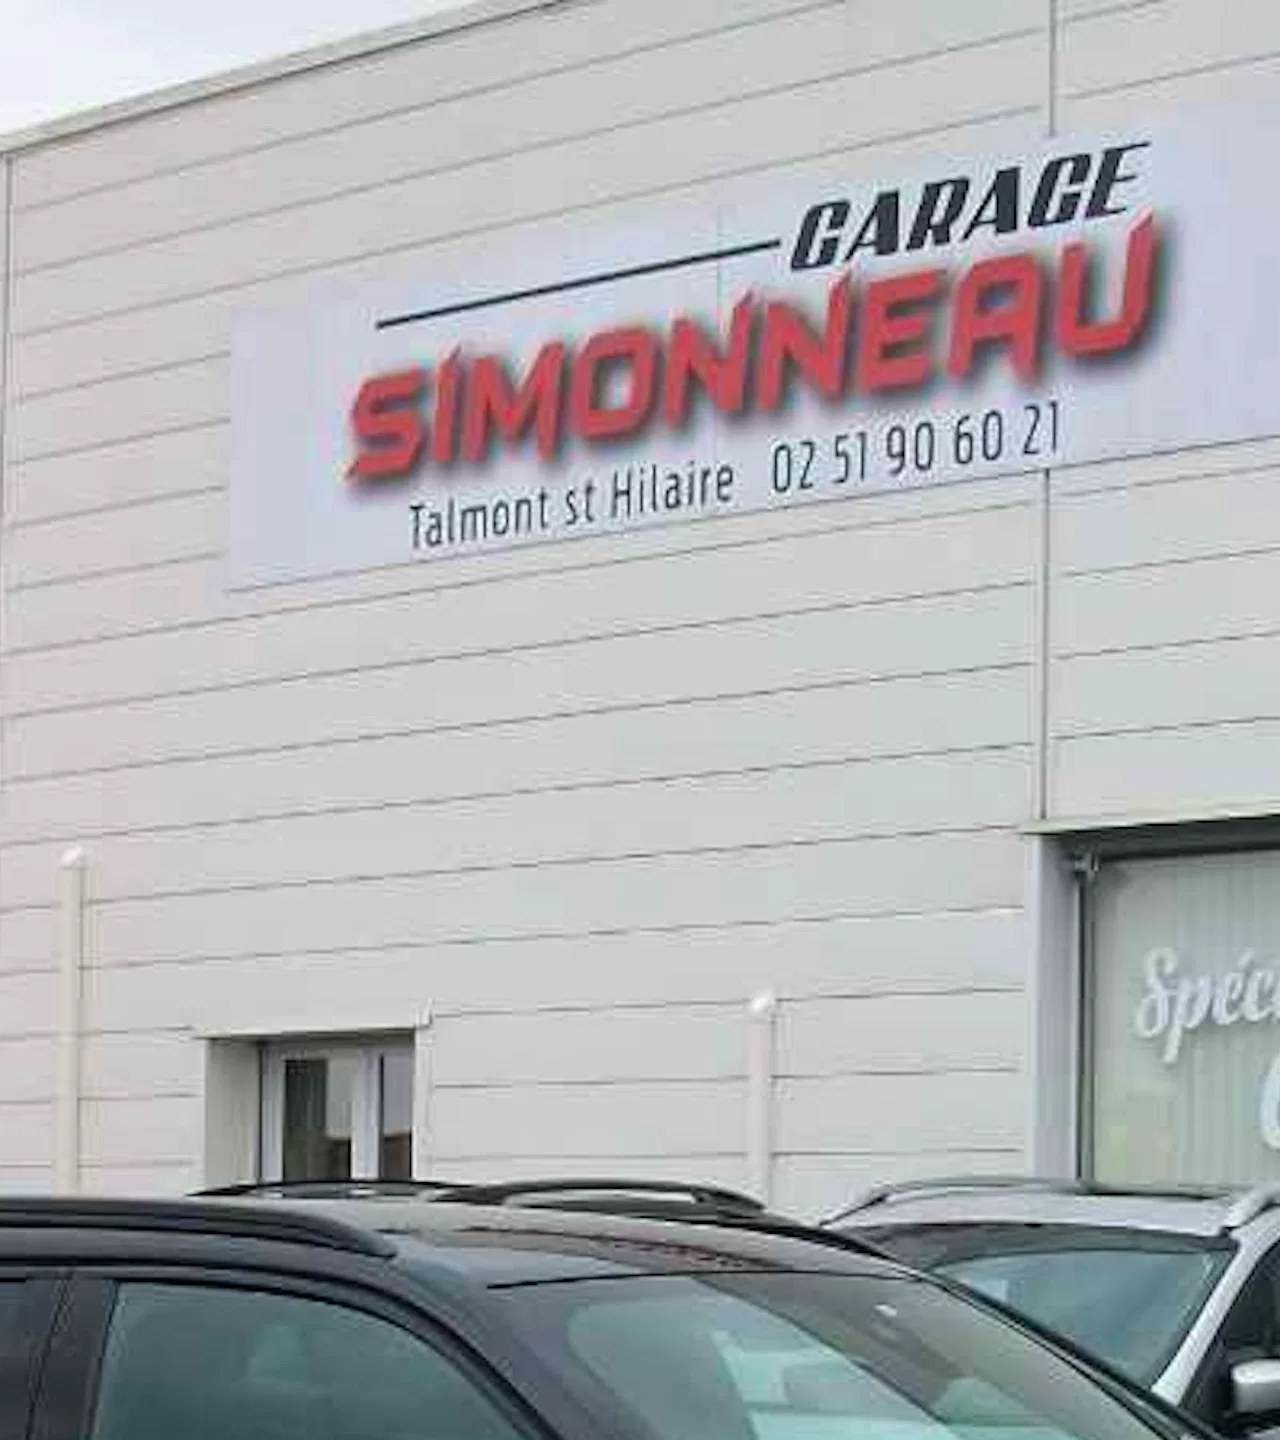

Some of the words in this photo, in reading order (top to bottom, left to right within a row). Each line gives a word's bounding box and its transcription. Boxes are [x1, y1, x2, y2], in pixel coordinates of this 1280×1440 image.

[791, 142, 1150, 269] GARAGE
[348, 207, 1160, 478] SIMONNEAU
[409, 490, 549, 550] Talmont
[565, 480, 597, 526] st
[611, 460, 735, 517] Hilaire
[772, 441, 816, 493] 02
[834, 431, 868, 483] 51
[887, 421, 934, 476] 90
[954, 411, 1003, 465] 60
[1024, 400, 1060, 453] 21
